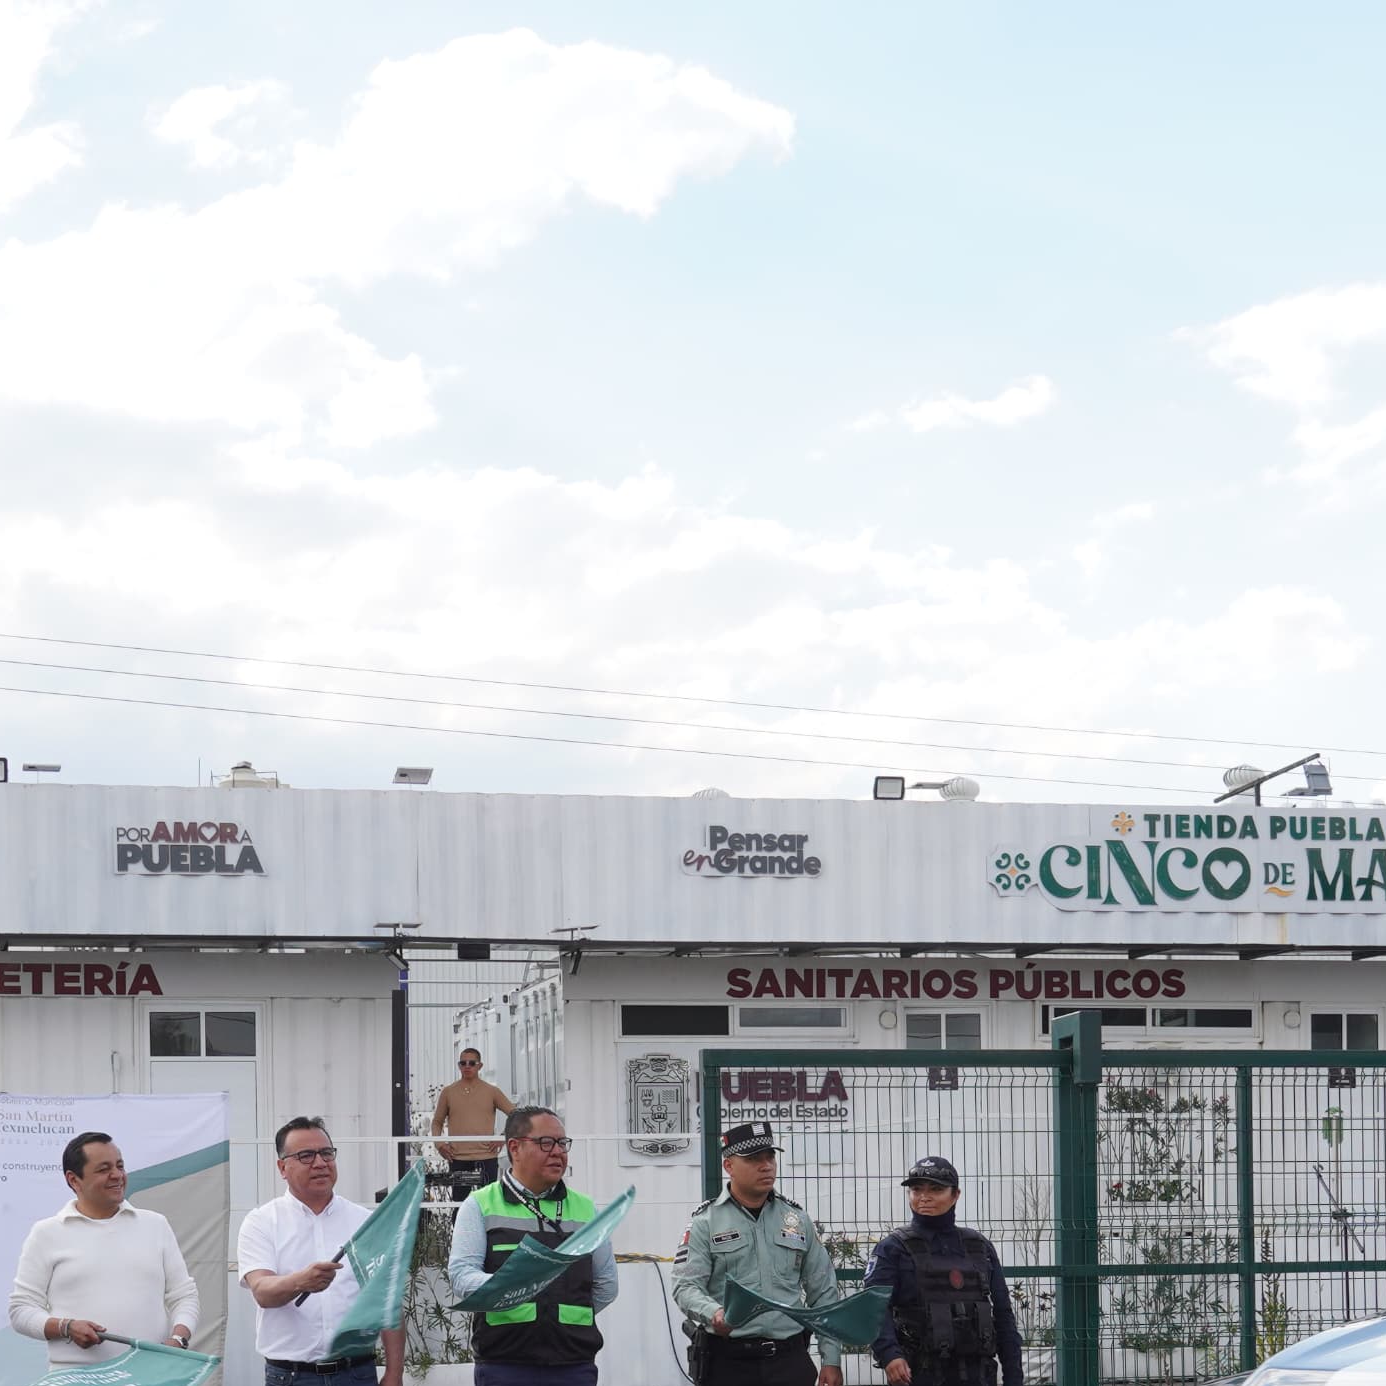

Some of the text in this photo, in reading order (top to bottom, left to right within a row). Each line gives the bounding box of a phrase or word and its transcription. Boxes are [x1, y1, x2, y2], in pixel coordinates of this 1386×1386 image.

[116, 821, 252, 844] POR AMOR A
[709, 825, 808, 852] Pensar
[1144, 814, 1385, 841] TIENDA PUEBLA
[116, 844, 265, 873] PUEBLA
[683, 848, 822, 875] en Grande
[1039, 840, 1251, 905] CINCO
[1263, 863, 1295, 885] DE
[726, 963, 1186, 999] SANITARIOS PÚBLICOS
[696, 1071, 848, 1102] UEBLA
[769, 1104, 792, 1118] del
[795, 1104, 849, 1118] Estado
